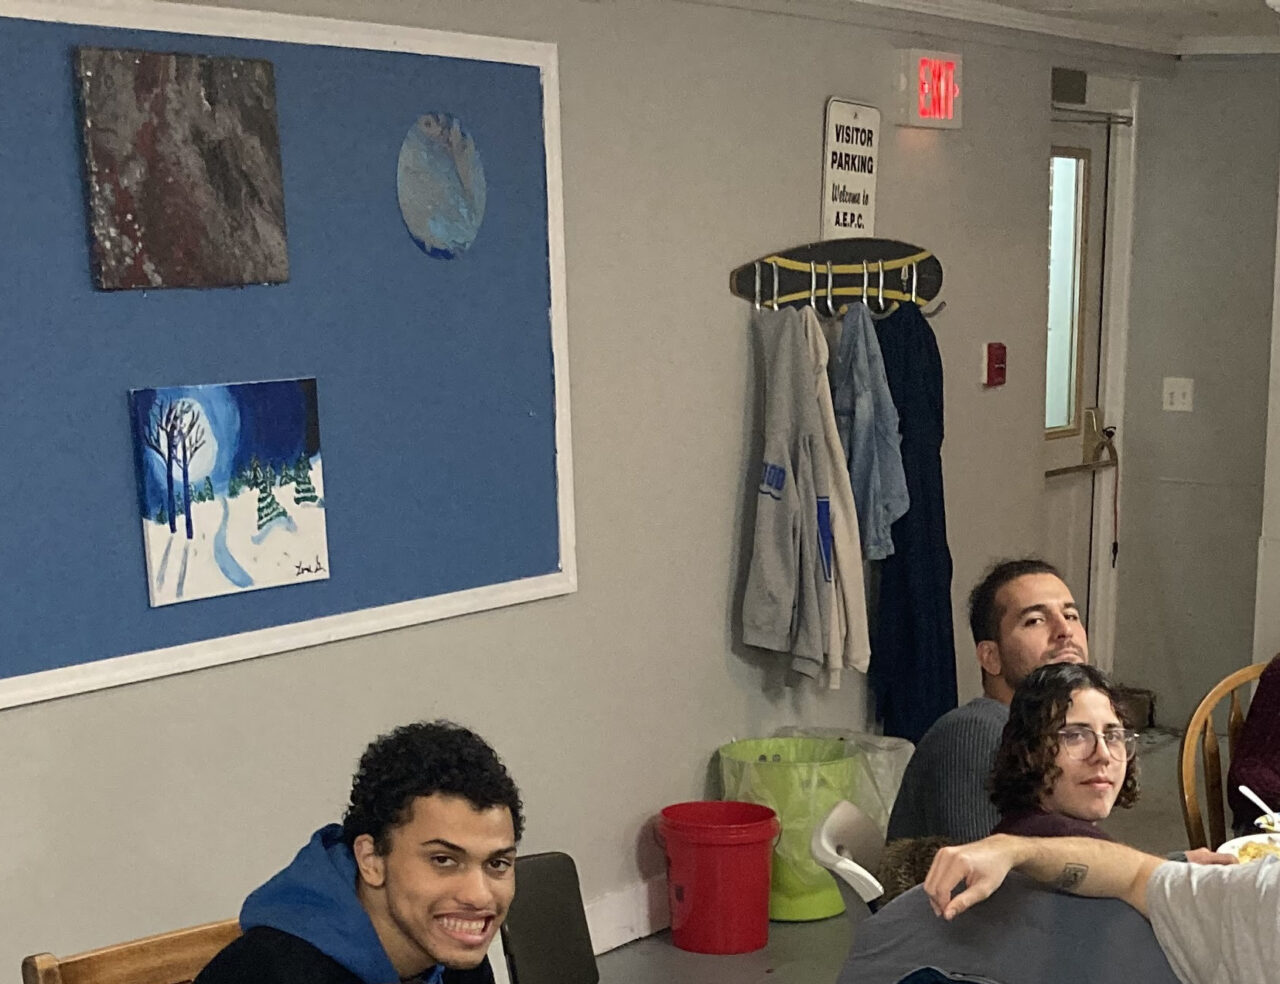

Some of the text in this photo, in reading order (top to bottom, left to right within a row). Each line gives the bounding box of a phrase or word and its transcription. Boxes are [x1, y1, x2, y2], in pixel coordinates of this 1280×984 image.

[918, 57, 955, 119] EXIT
[835, 123, 874, 148] VISITOR
[830, 151, 874, 175] PARKING
[831, 183, 869, 206] Welcome to
[834, 211, 865, 230] A.E.P.C.
